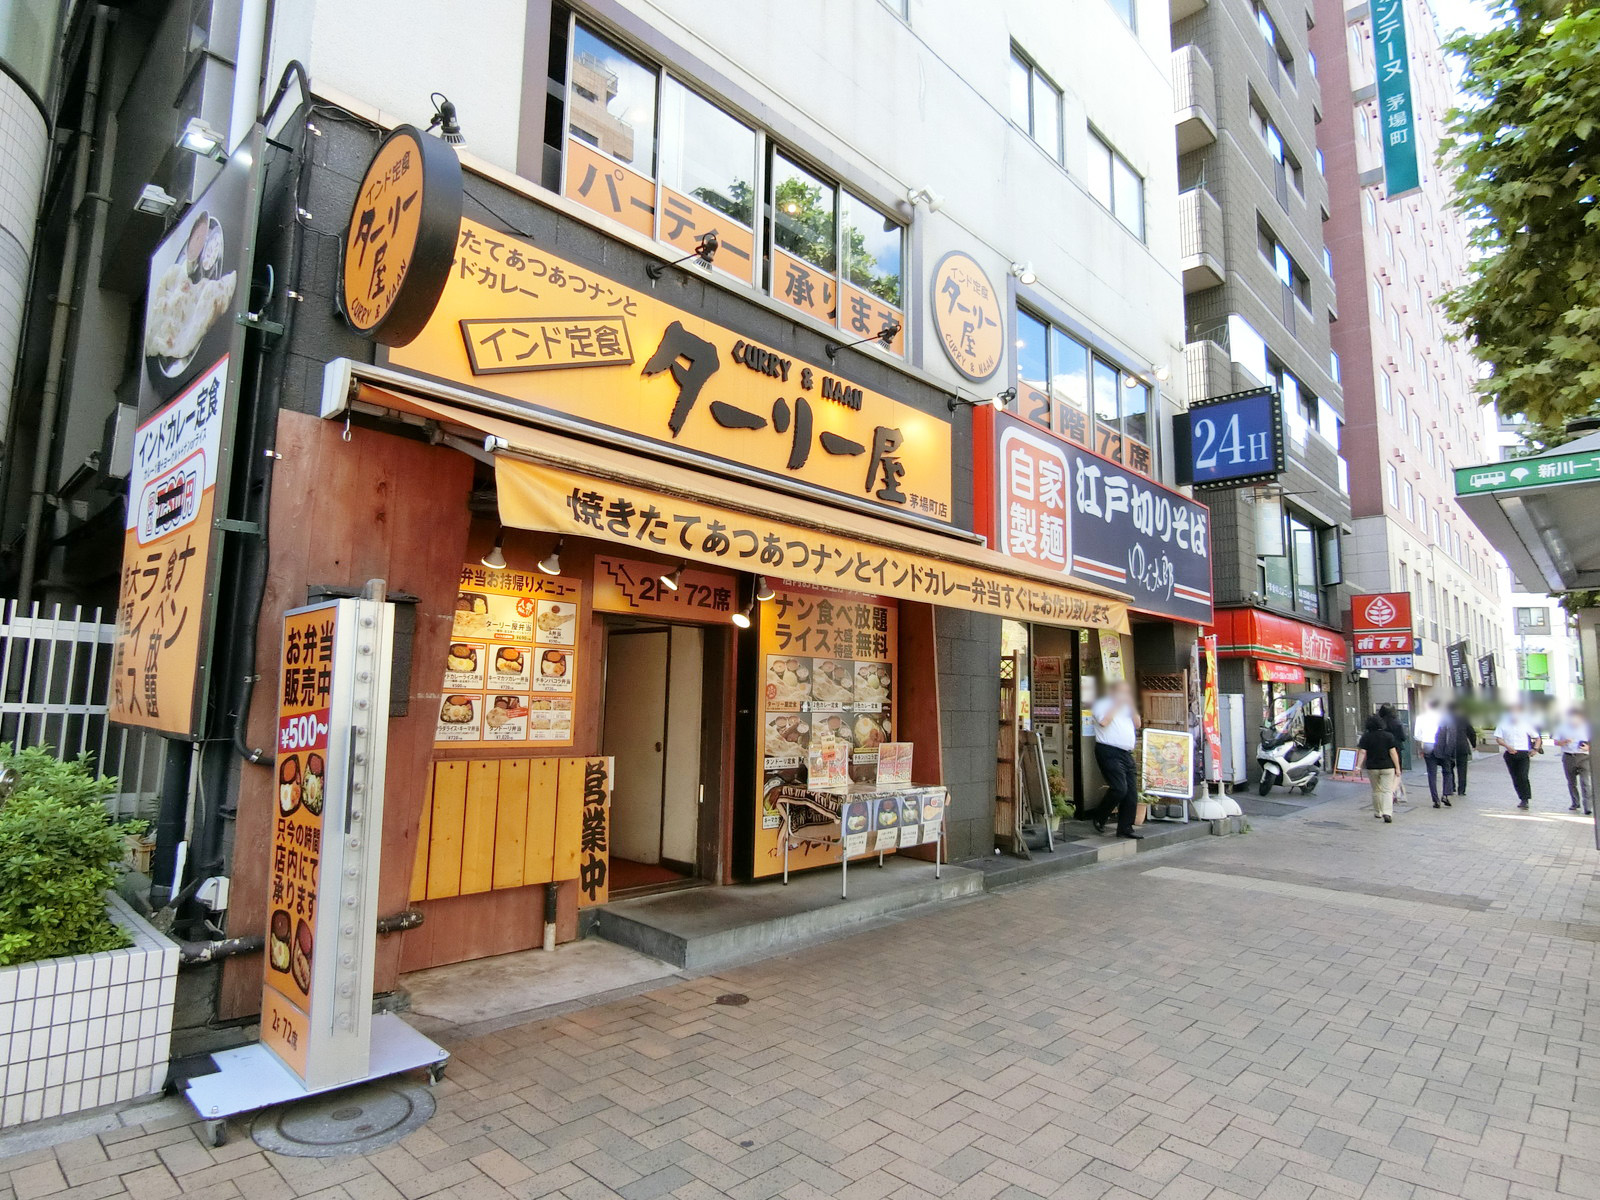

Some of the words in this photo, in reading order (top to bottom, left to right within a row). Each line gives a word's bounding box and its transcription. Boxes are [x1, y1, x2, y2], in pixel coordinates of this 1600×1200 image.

[1376, 0, 1404, 82] ンテーヌ
[1386, 92, 1409, 147] 茅場町
[366, 151, 412, 205] インド定食
[353, 190, 418, 271] ターリー
[351, 298, 372, 324] CURRY
[385, 259, 407, 309] NAAN
[367, 240, 388, 300] 屋
[453, 256, 540, 299] ドカレー
[950, 267, 990, 302] インド定食
[941, 275, 997, 329] ターリー
[479, 324, 625, 363] インド定食
[945, 333, 967, 367] CURRY
[978, 355, 995, 375] NAAN
[959, 321, 977, 359] 屋
[731, 339, 792, 382] CURRY
[800, 367, 815, 392] &
[821, 376, 864, 411] NAAN
[139, 376, 221, 469] インドカレー定食
[641, 320, 908, 505] ターリー屋
[1193, 413, 1269, 469] 24H
[1010, 448, 1064, 510] 自家
[908, 493, 949, 519] 茅場町店
[1076, 457, 1207, 558] 江戸切りそば
[1010, 502, 1065, 565] 製麺
[459, 567, 577, 596] 弁当お持帰りメニュー
[128, 552, 163, 717] ライス
[144, 548, 176, 718] 食べ放題
[775, 593, 889, 633] ナン食べ放題
[286, 620, 335, 665] お弁当
[775, 623, 832, 654] ライス
[855, 630, 889, 660] 無料
[1357, 634, 1407, 650] ポプラ
[283, 664, 332, 708] 販売中
[1021, 698, 1029, 714] た
[276, 818, 321, 855] 只今の時間
[580, 759, 609, 901] 営業中
[274, 845, 319, 888] 店内にて
[272, 875, 317, 922] 承ります
